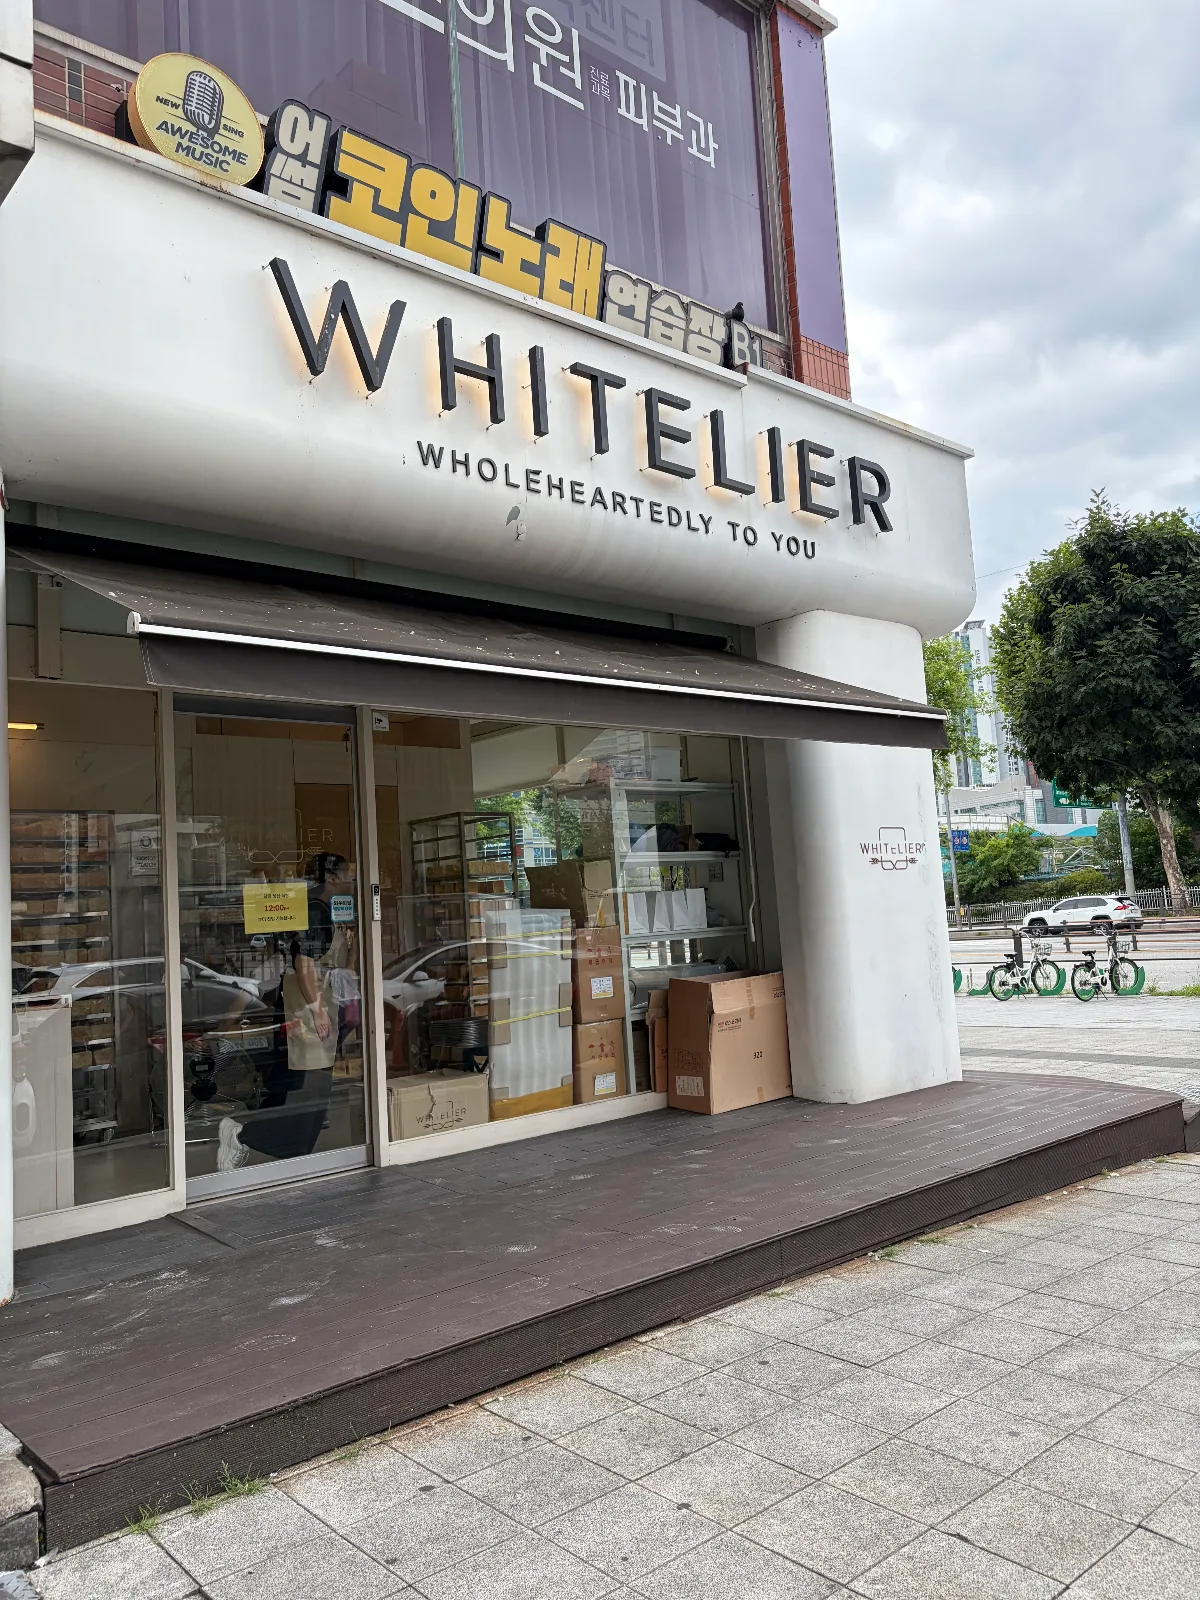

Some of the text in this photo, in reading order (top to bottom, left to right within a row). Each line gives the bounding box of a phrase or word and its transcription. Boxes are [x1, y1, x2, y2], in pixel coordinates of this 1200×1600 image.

[155, 95, 181, 110] NEW
[615, 69, 719, 168] 피부과
[155, 120, 249, 166] AWESOME
[222, 123, 245, 138] SING
[174, 141, 231, 173] MUSIC
[267, 256, 894, 534] WHITELIER
[416, 440, 818, 560] WHOLEHEARTEDLY TO YOU
